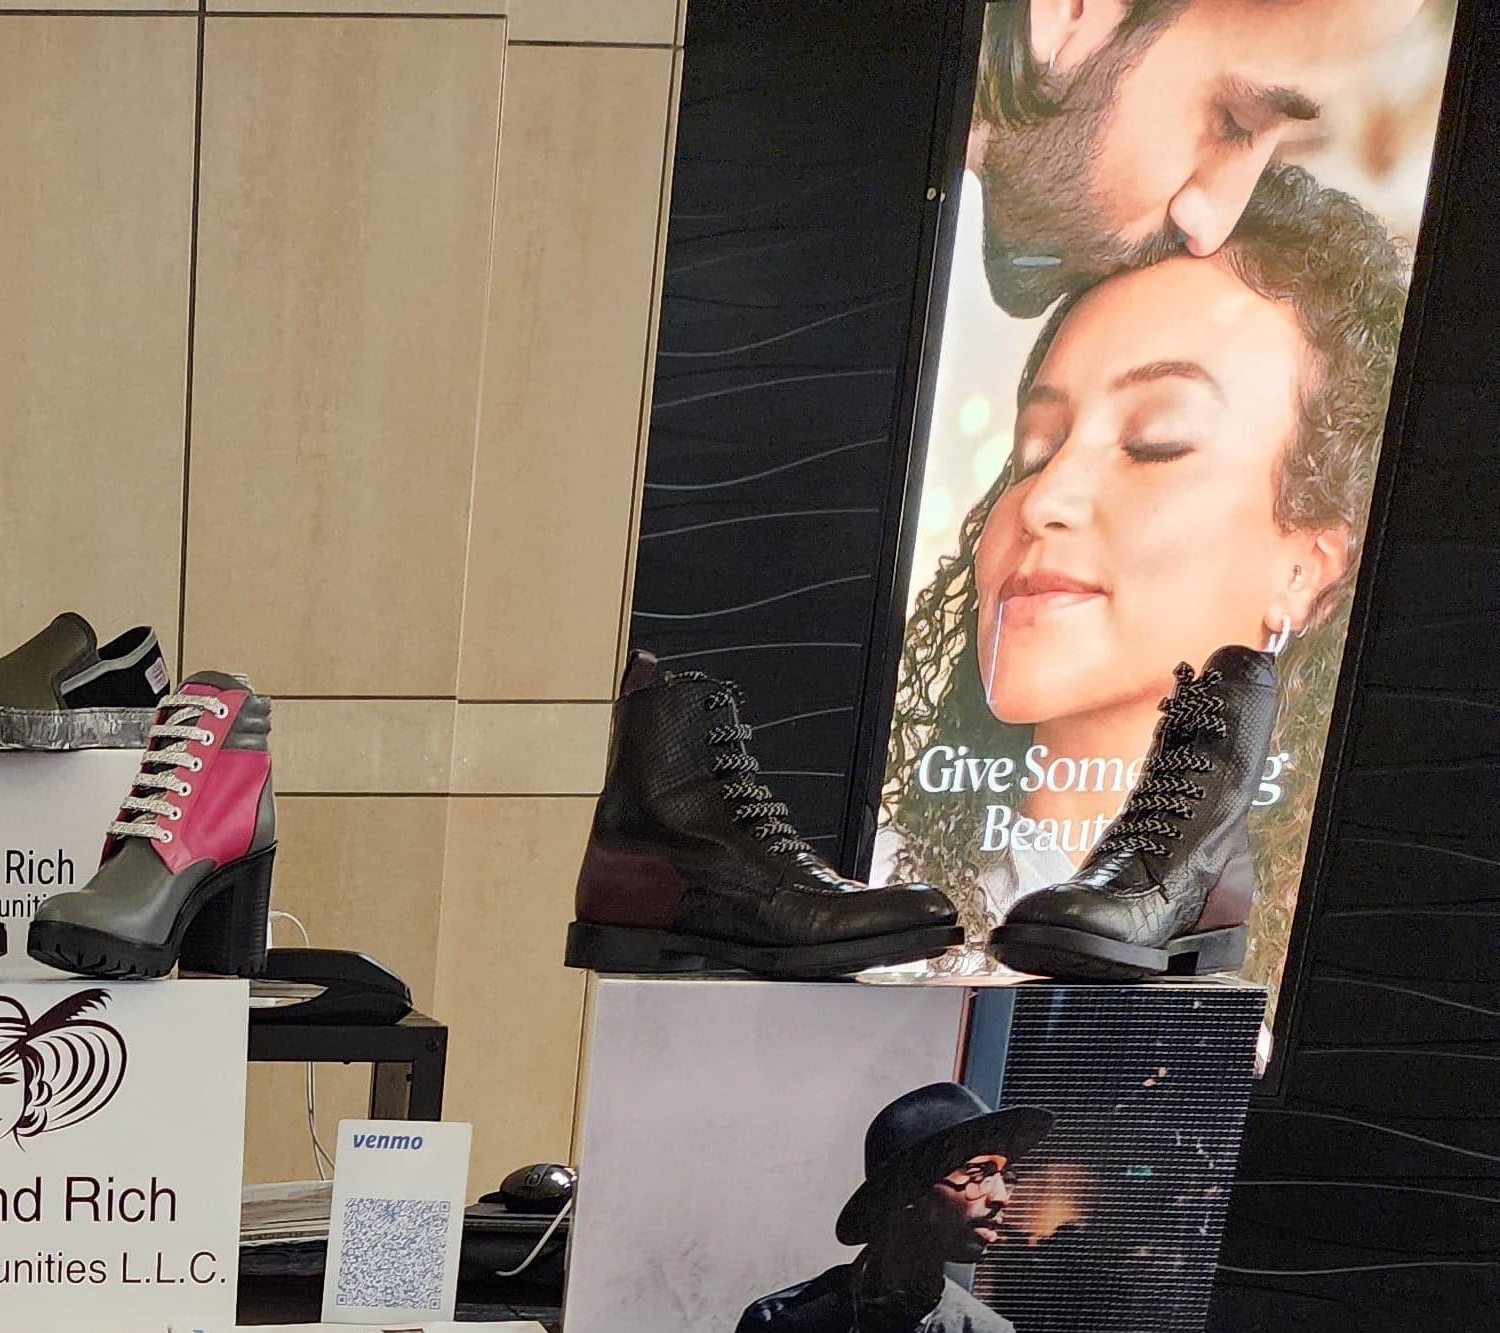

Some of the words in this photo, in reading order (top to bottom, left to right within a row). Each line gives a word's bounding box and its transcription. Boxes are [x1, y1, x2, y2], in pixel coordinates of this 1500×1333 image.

[918, 744, 1013, 793] Give
[1019, 744, 1290, 807] Someg
[980, 805, 1124, 852] Beaut
[5, 848, 75, 885] Rich
[353, 1133, 424, 1150] venmo
[65, 1176, 178, 1223] Rich
[121, 1250, 227, 1284] L.L.C.
